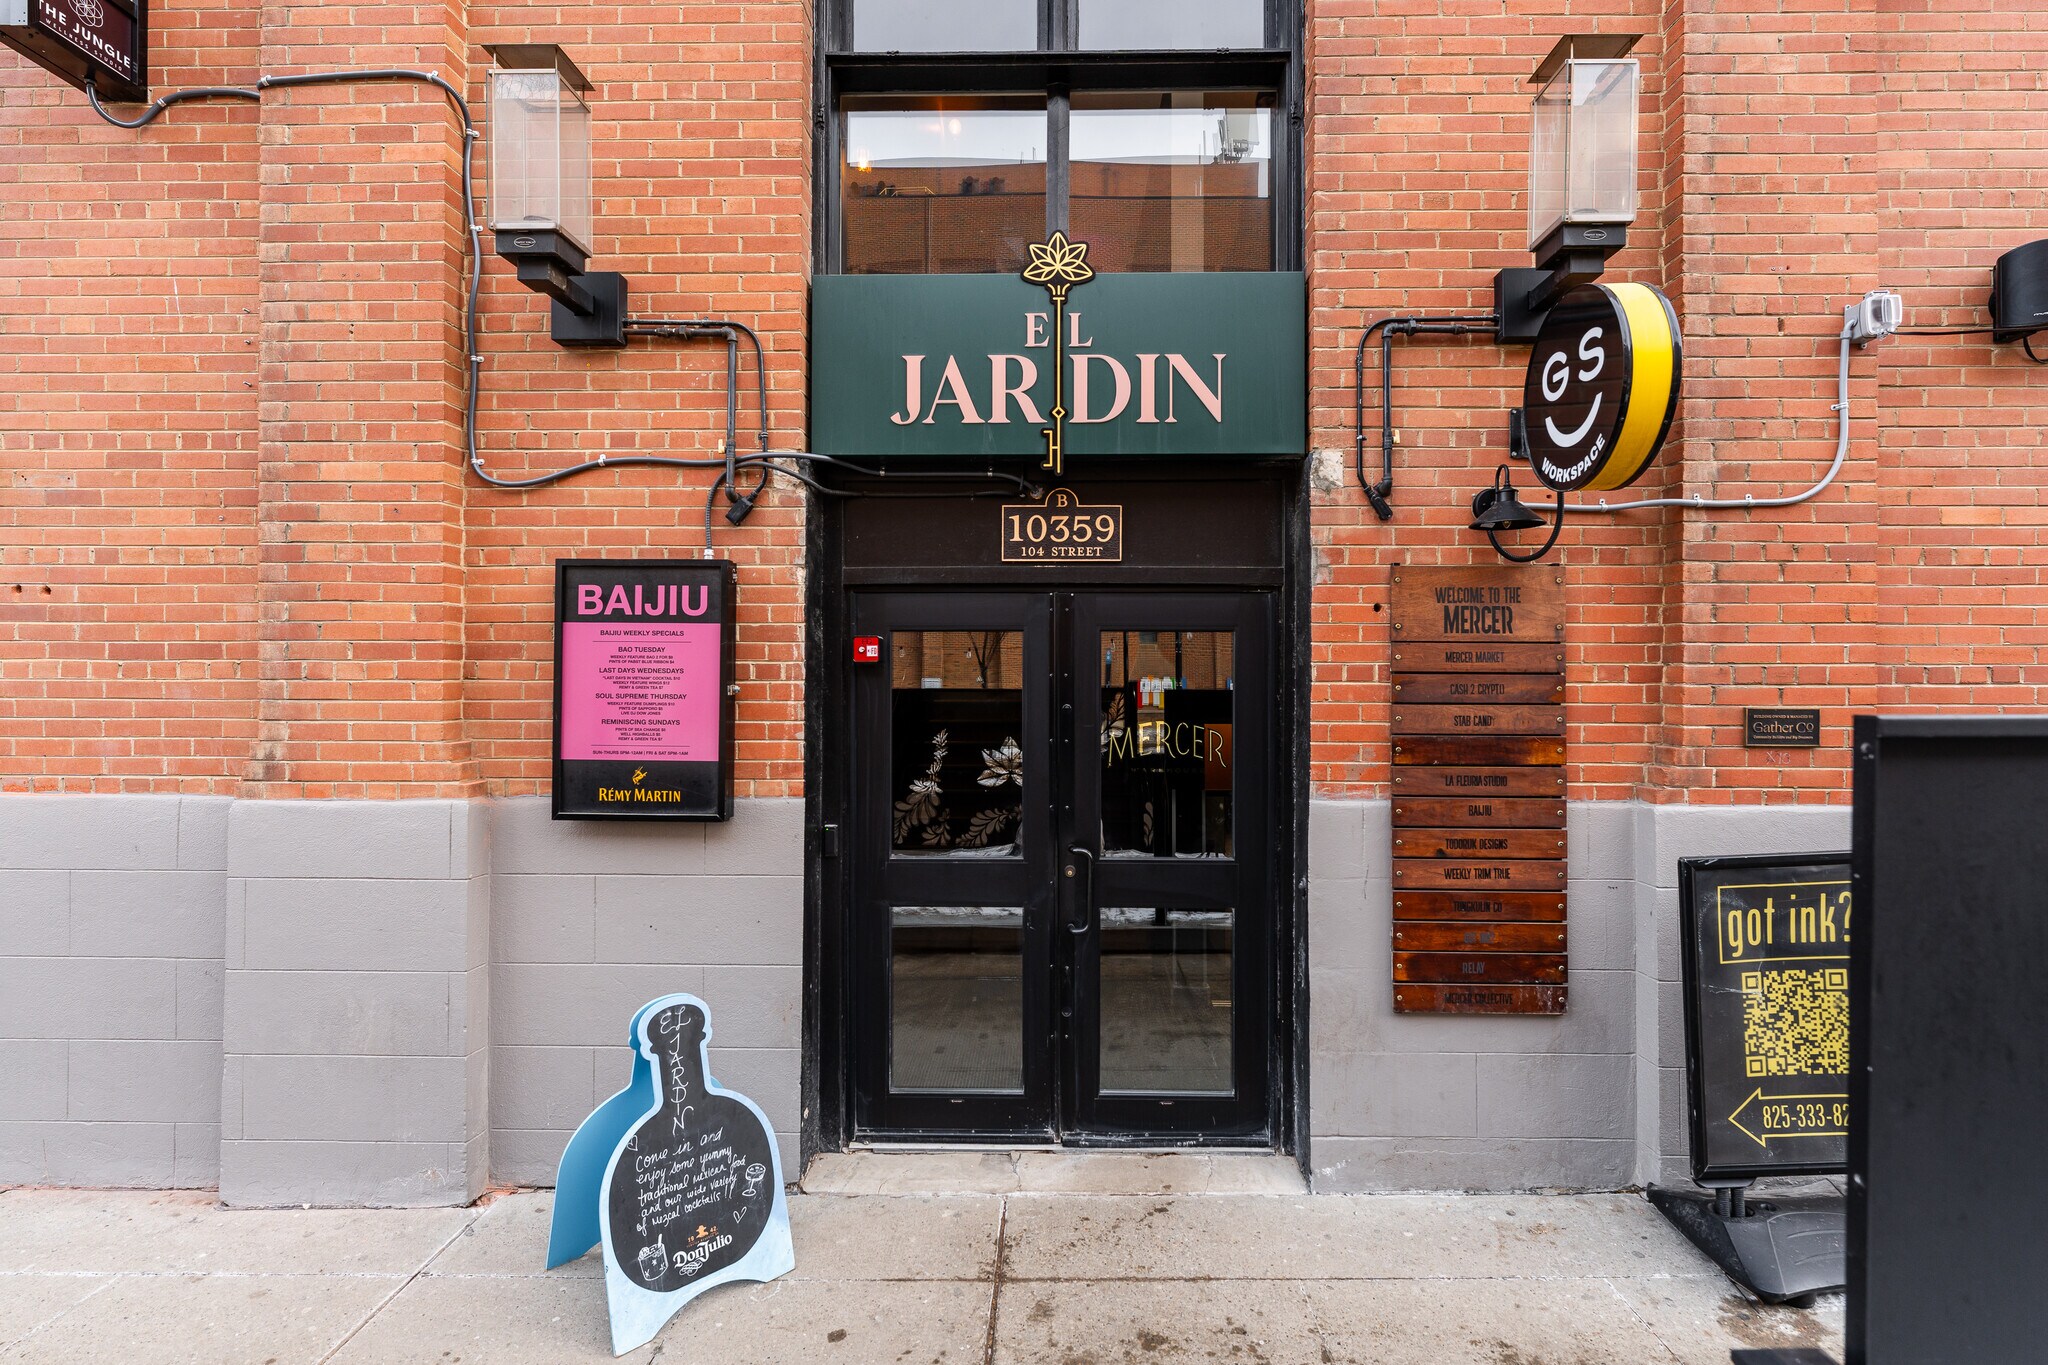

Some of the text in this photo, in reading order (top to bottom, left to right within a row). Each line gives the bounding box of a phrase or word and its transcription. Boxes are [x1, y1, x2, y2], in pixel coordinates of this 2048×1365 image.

[45, 18, 123, 71] WELLNESS STUDIO
[73, 22, 131, 69] JUNGLE
[1542, 326, 1605, 402] GS
[890, 354, 1227, 425] JARDIN
[1541, 432, 1606, 483] WORKSPACE
[1056, 494, 1068, 507] B
[1008, 514, 1115, 543] 10359
[1021, 546, 1104, 557] 104 STREET
[577, 584, 709, 616] BAIJIU
[1435, 586, 1521, 604] WELCOME TO THE
[1443, 605, 1514, 635] MERCER
[1445, 651, 1504, 663] MERCER MARKET
[1450, 683, 1505, 695] CASH 2 CRYPTO
[1752, 720, 1794, 733] Gather
[1107, 720, 1227, 769] MERCER
[599, 786, 681, 803] RÉMY MARTIN
[1445, 775, 1454, 786] LA
[1483, 775, 1508, 787] STUDIO
[1468, 804, 1492, 817] BAIJIU
[1479, 838, 1508, 850] DESIGNS
[1444, 867, 1510, 880] WEEKLY TRIM TRUE
[1493, 901, 1502, 913] CO
[1727, 891, 1852, 957] got ink?
[1462, 961, 1485, 974] RELAY
[669, 1033, 694, 1137] JARDIN
[636, 1127, 724, 1173] Come in and
[636, 1146, 732, 1190] enjoy some yummy
[638, 1174, 689, 1207] traditional
[641, 1173, 738, 1218] and our wide variety
[636, 1215, 648, 1237] of
